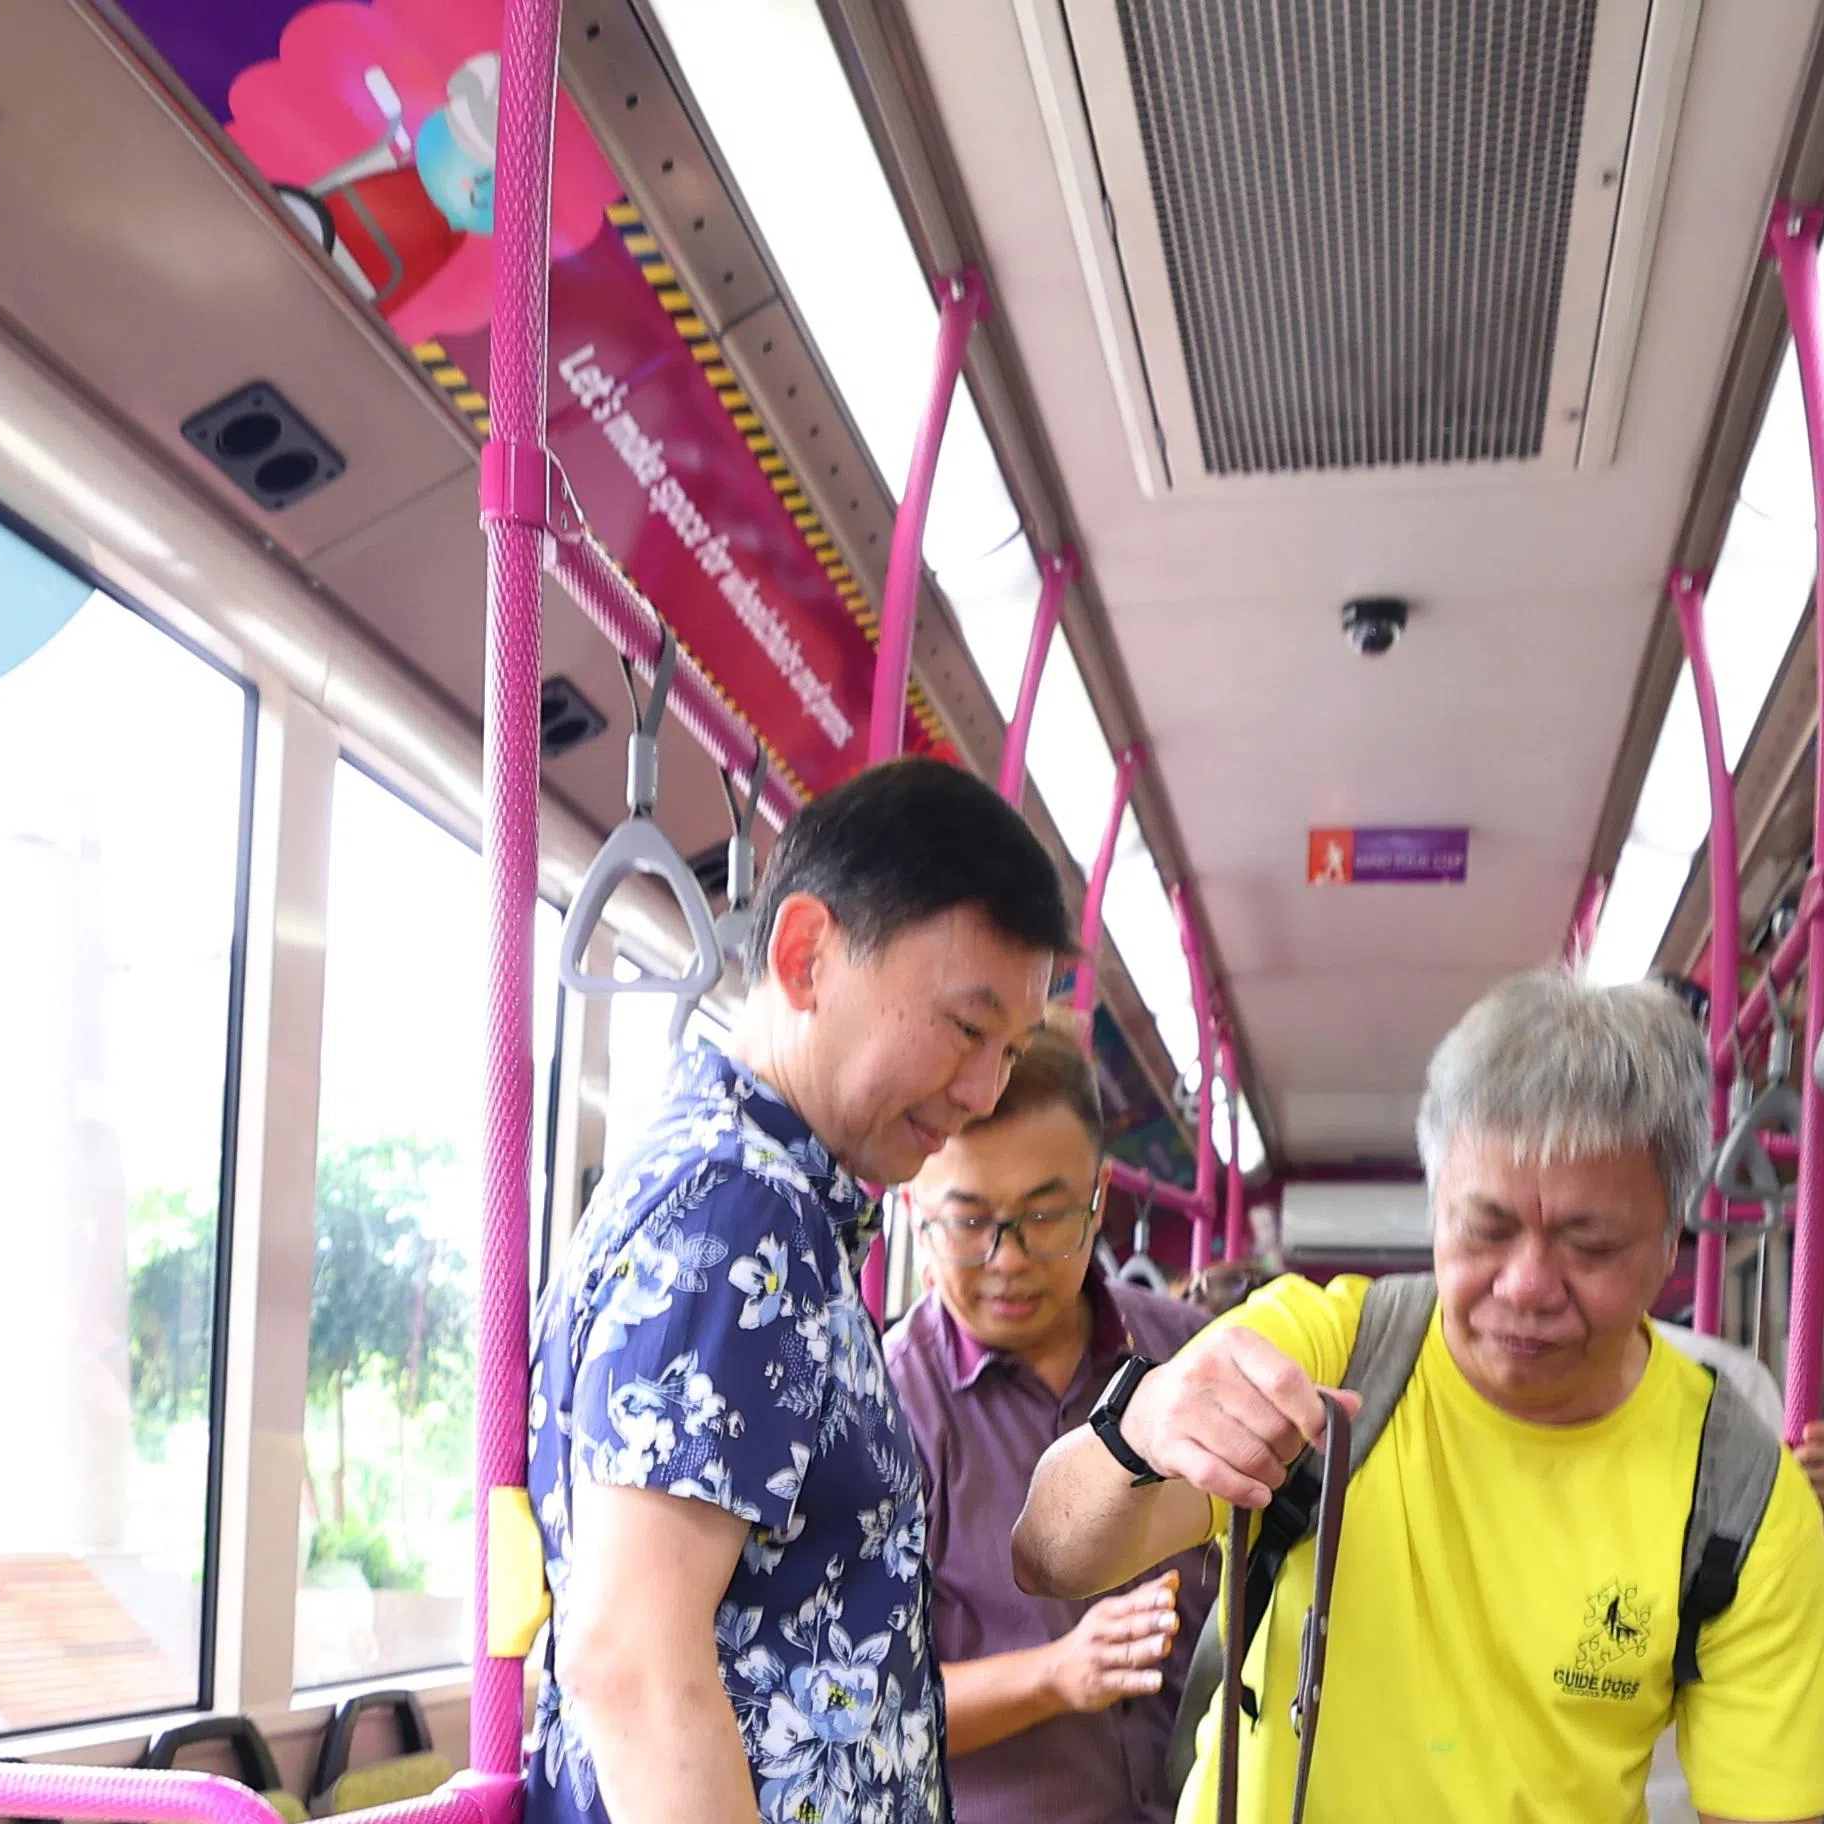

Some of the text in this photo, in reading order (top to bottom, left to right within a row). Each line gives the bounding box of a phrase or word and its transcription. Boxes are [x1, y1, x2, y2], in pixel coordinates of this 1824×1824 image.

[558, 343, 629, 423] Let's
[602, 411, 667, 487] make
[649, 475, 711, 548] space
[694, 531, 734, 577] for
[1553, 1667, 1599, 1691] GUIDE
[1600, 1676, 1641, 1695] DOGS
